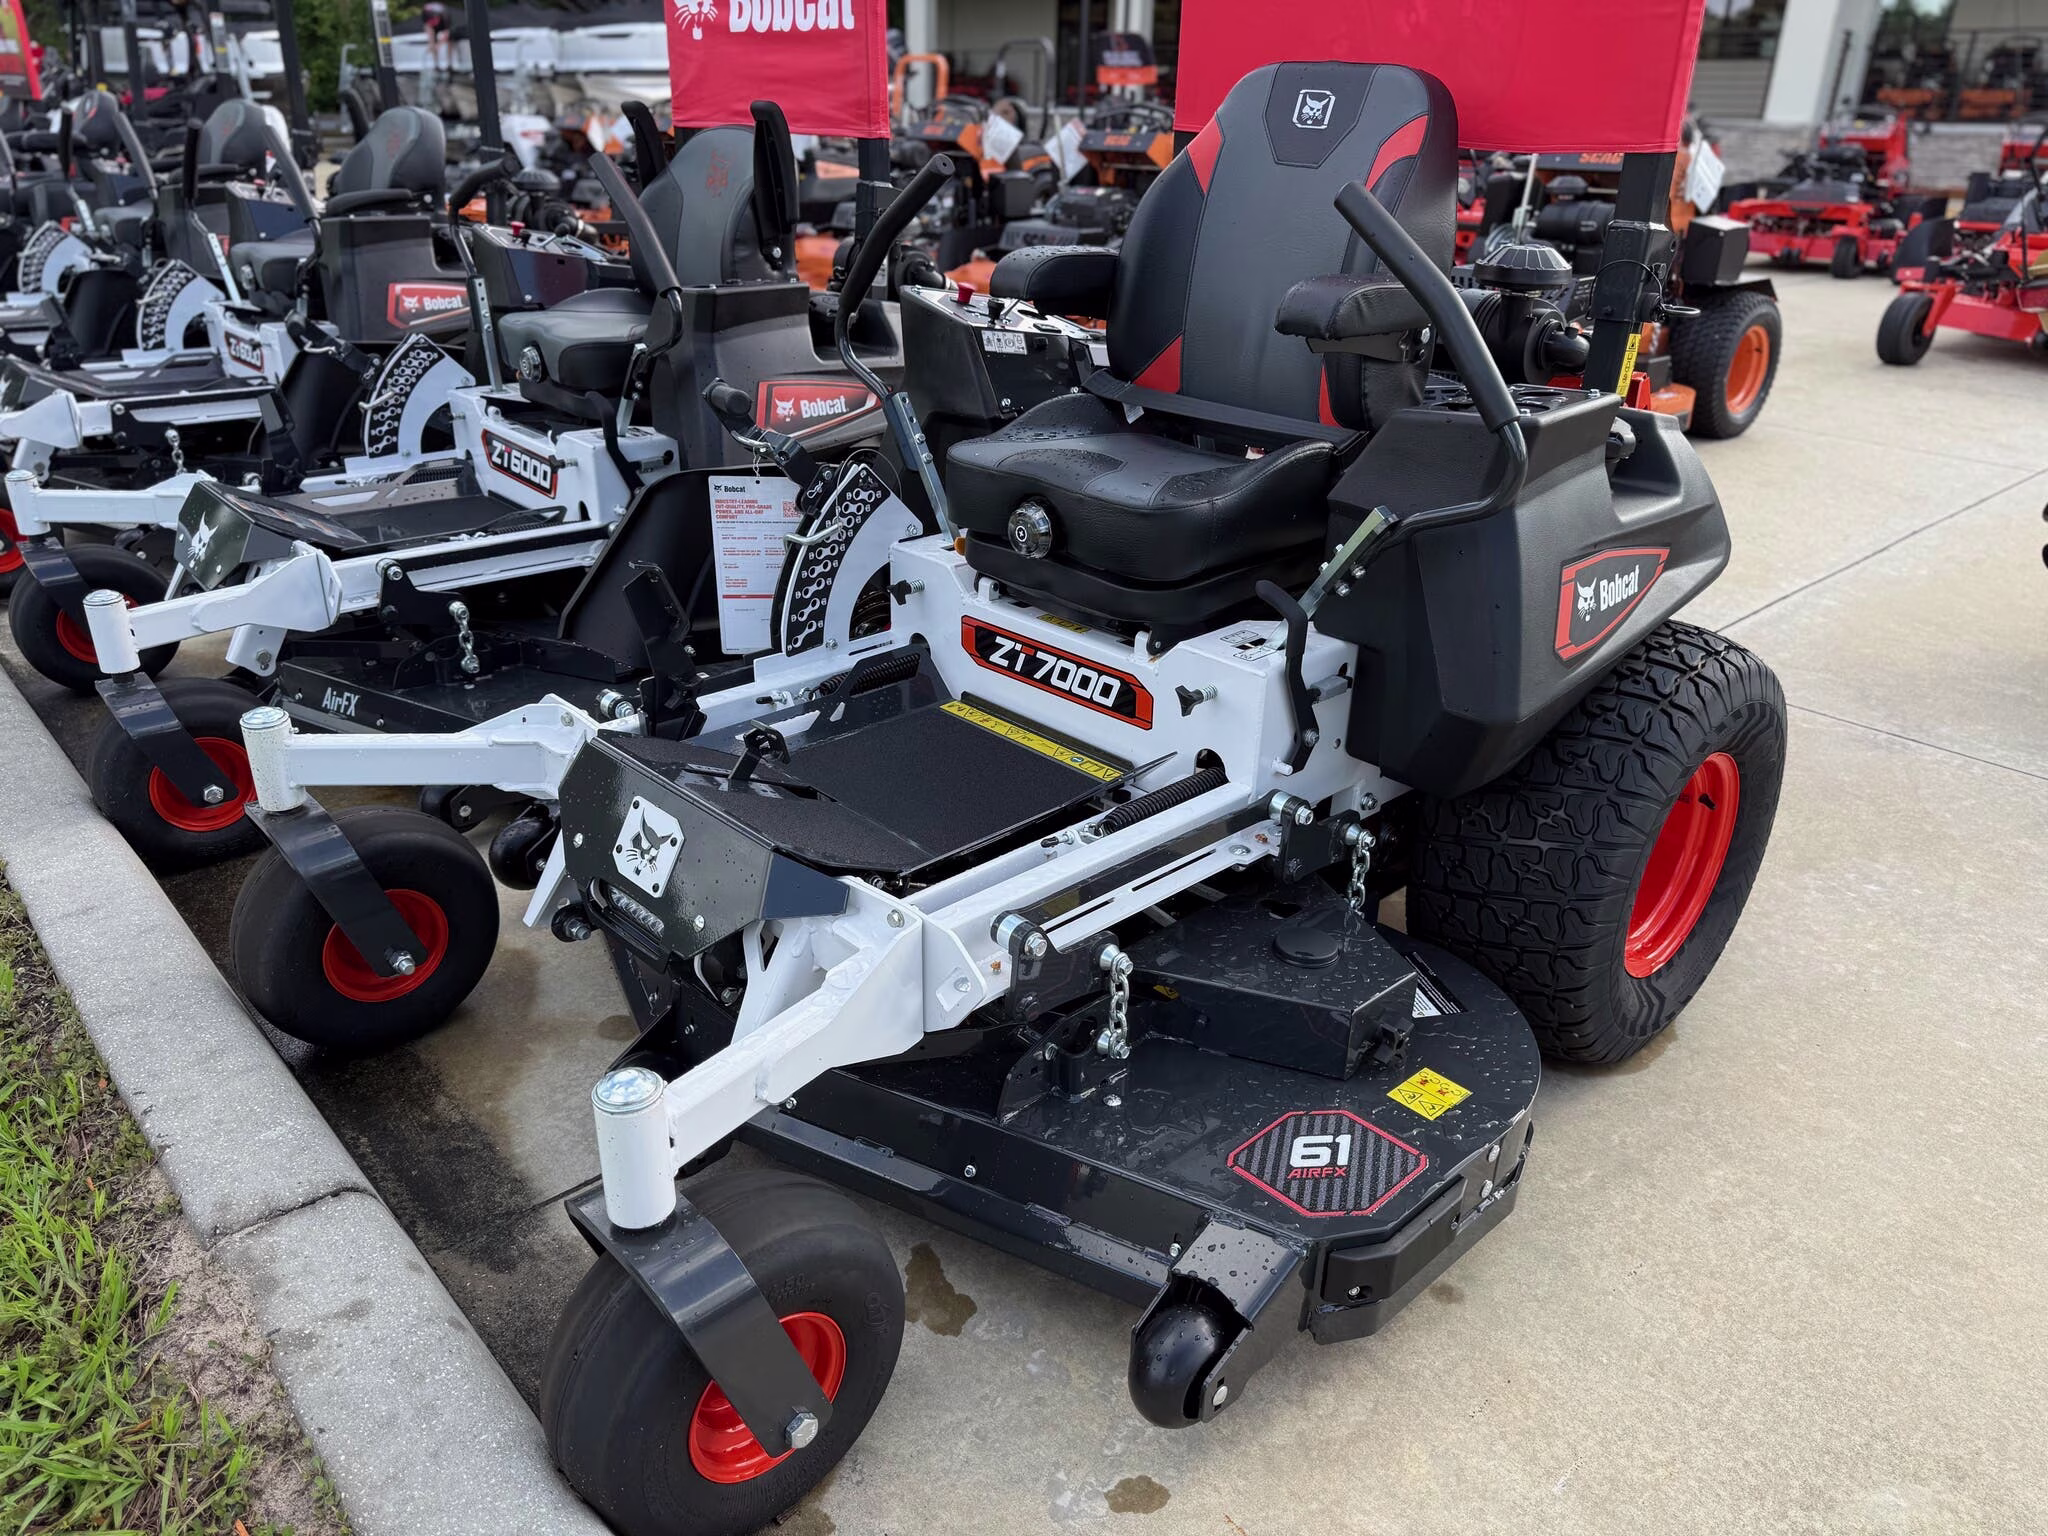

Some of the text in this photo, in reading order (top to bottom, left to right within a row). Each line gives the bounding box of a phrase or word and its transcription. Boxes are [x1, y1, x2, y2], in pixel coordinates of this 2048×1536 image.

[423, 294, 464, 312] Bobcat
[800, 395, 848, 419] Bobcat
[724, 485, 746, 493] Bobcat
[1599, 564, 1640, 612] Bobcat
[322, 687, 361, 717] AirFX
[1289, 1134, 1352, 1168] 61
[1287, 1166, 1348, 1180] AIRFX
